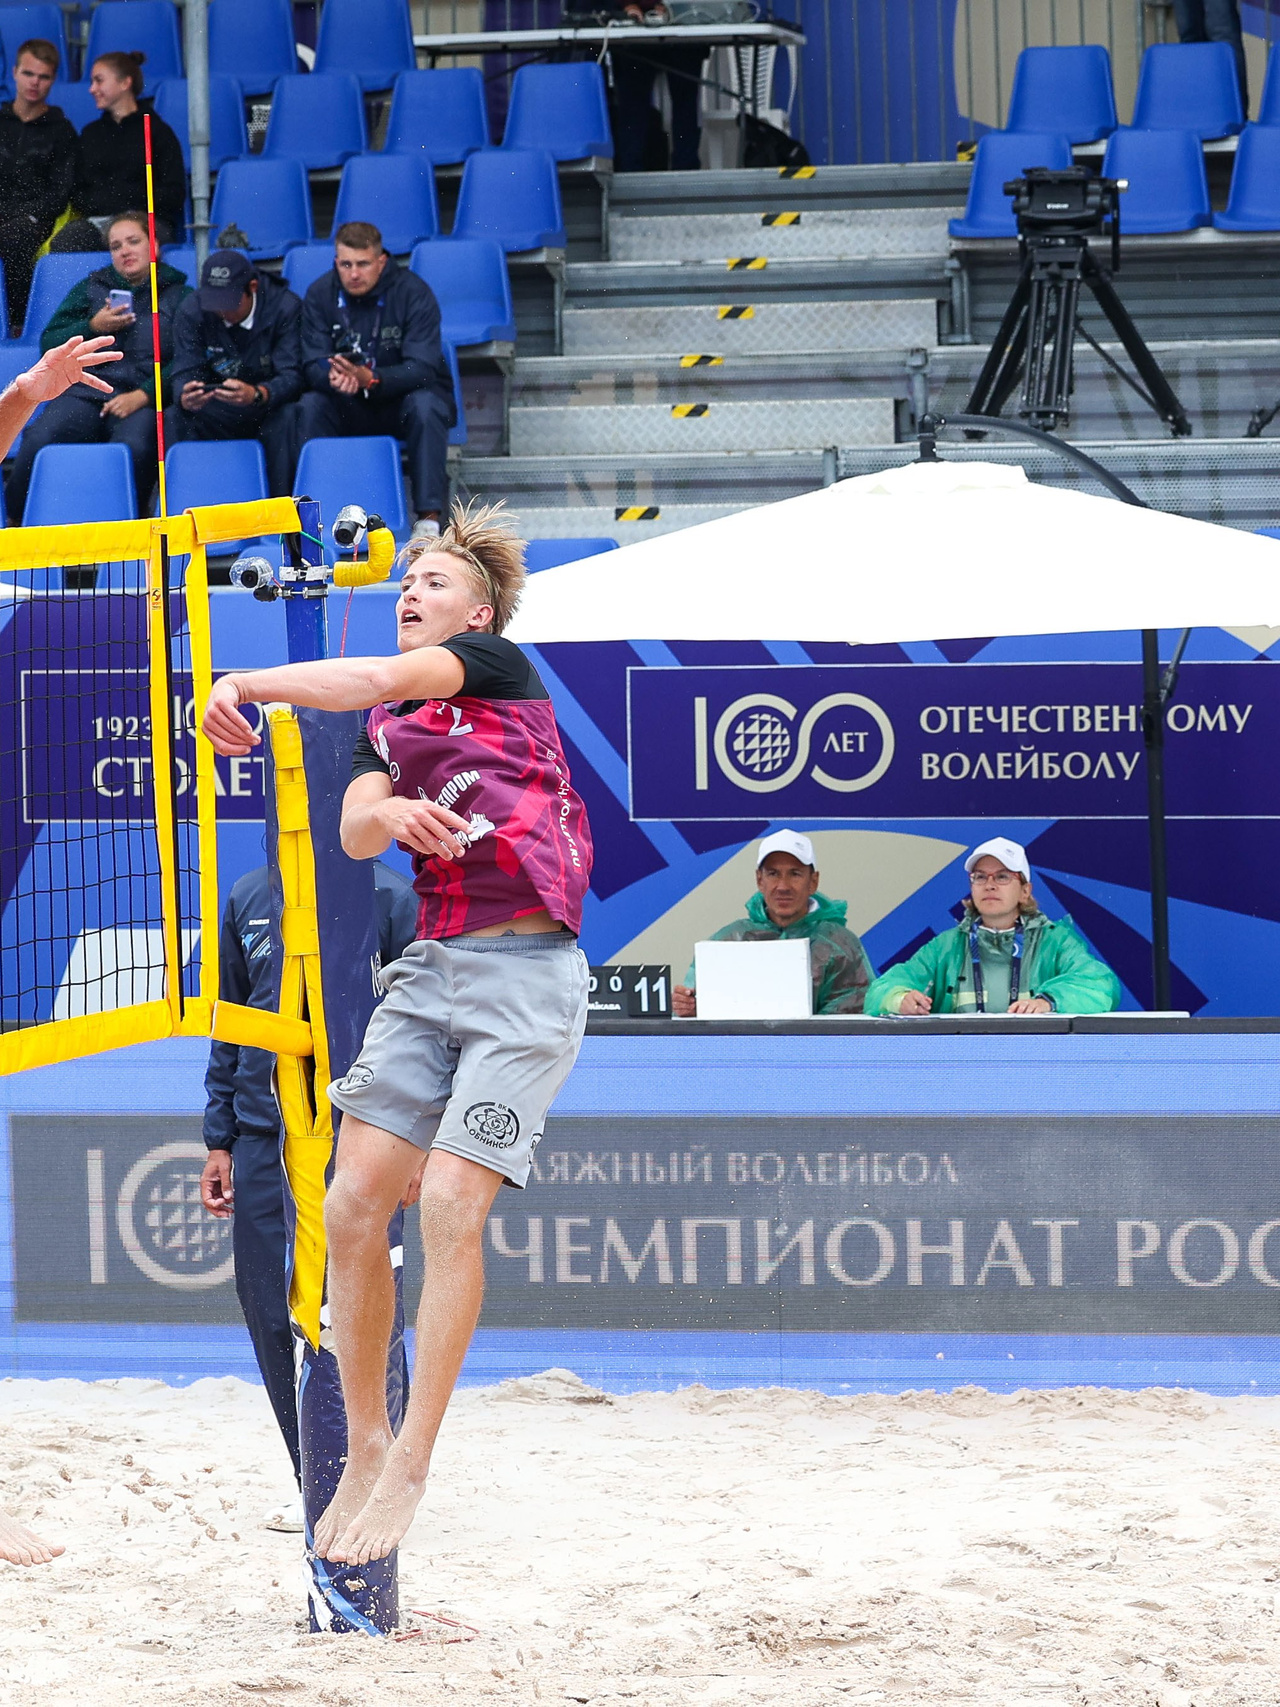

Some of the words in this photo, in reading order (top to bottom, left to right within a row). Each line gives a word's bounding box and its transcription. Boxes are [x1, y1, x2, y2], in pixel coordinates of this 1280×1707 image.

[436, 702, 474, 737] 2
[919, 704, 1253, 734] ОТЕЧЕСТВЕНОМУ
[823, 732, 869, 753] ЛЕТ
[921, 745, 1141, 781] ВОЛЕЙБОЛУ
[610, 976, 623, 992] 0
[634, 976, 667, 1012] 11
[468, 1128, 509, 1149] ОБНИНСК
[727, 1143, 959, 1186] ВОЛЕЙБОЛ
[489, 1216, 1079, 1287] ЧЕМПИОНАТ
